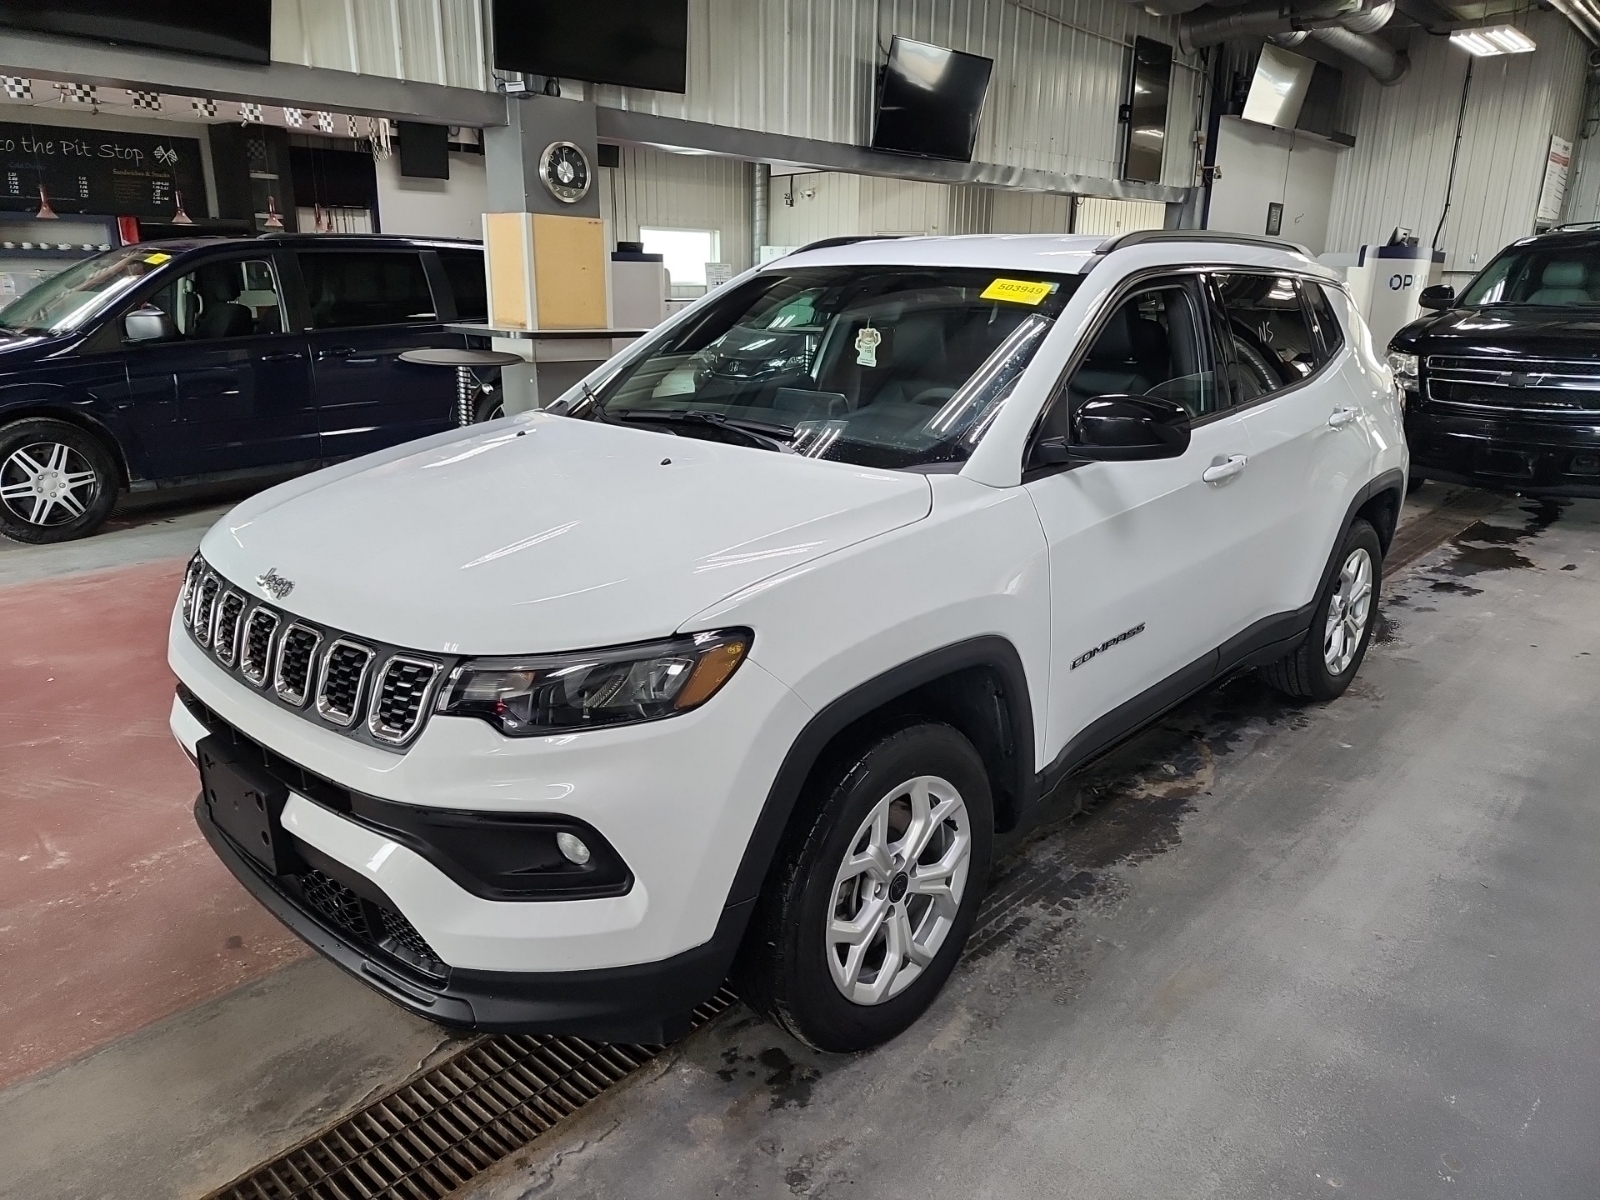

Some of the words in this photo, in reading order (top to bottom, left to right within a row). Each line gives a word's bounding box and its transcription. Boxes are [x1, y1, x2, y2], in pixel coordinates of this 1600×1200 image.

[21, 136, 55, 155] the
[59, 138, 92, 157] Pit
[97, 143, 144, 167] Stop
[997, 283, 1044, 295] 503949
[256, 567, 296, 601] Jeep
[1069, 621, 1146, 671] COMPASS
